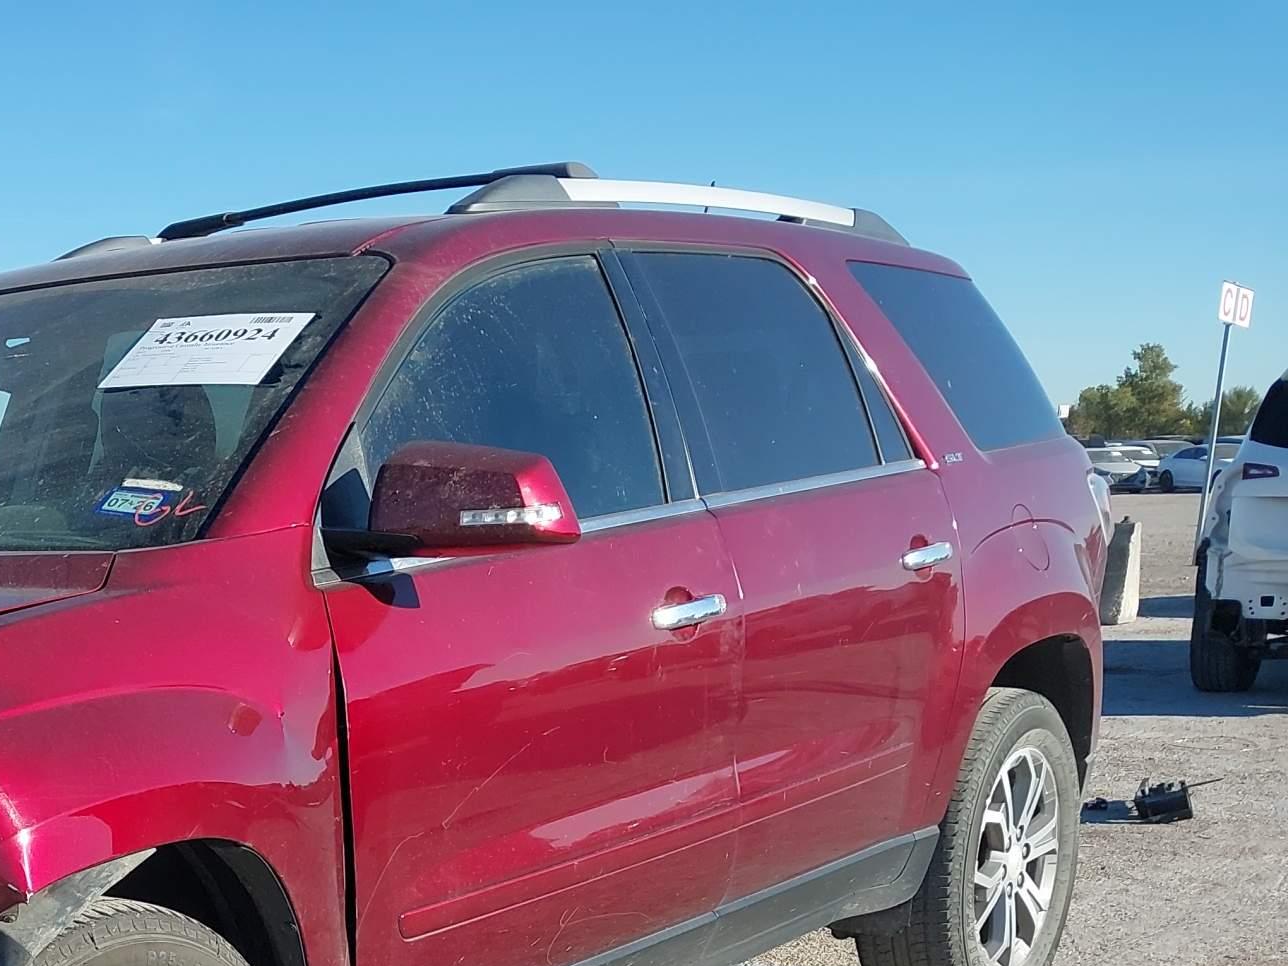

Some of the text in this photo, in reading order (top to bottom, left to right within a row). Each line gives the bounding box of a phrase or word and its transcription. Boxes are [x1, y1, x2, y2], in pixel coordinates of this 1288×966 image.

[1223, 287, 1249, 321] C D
[154, 327, 280, 345] 43660924
